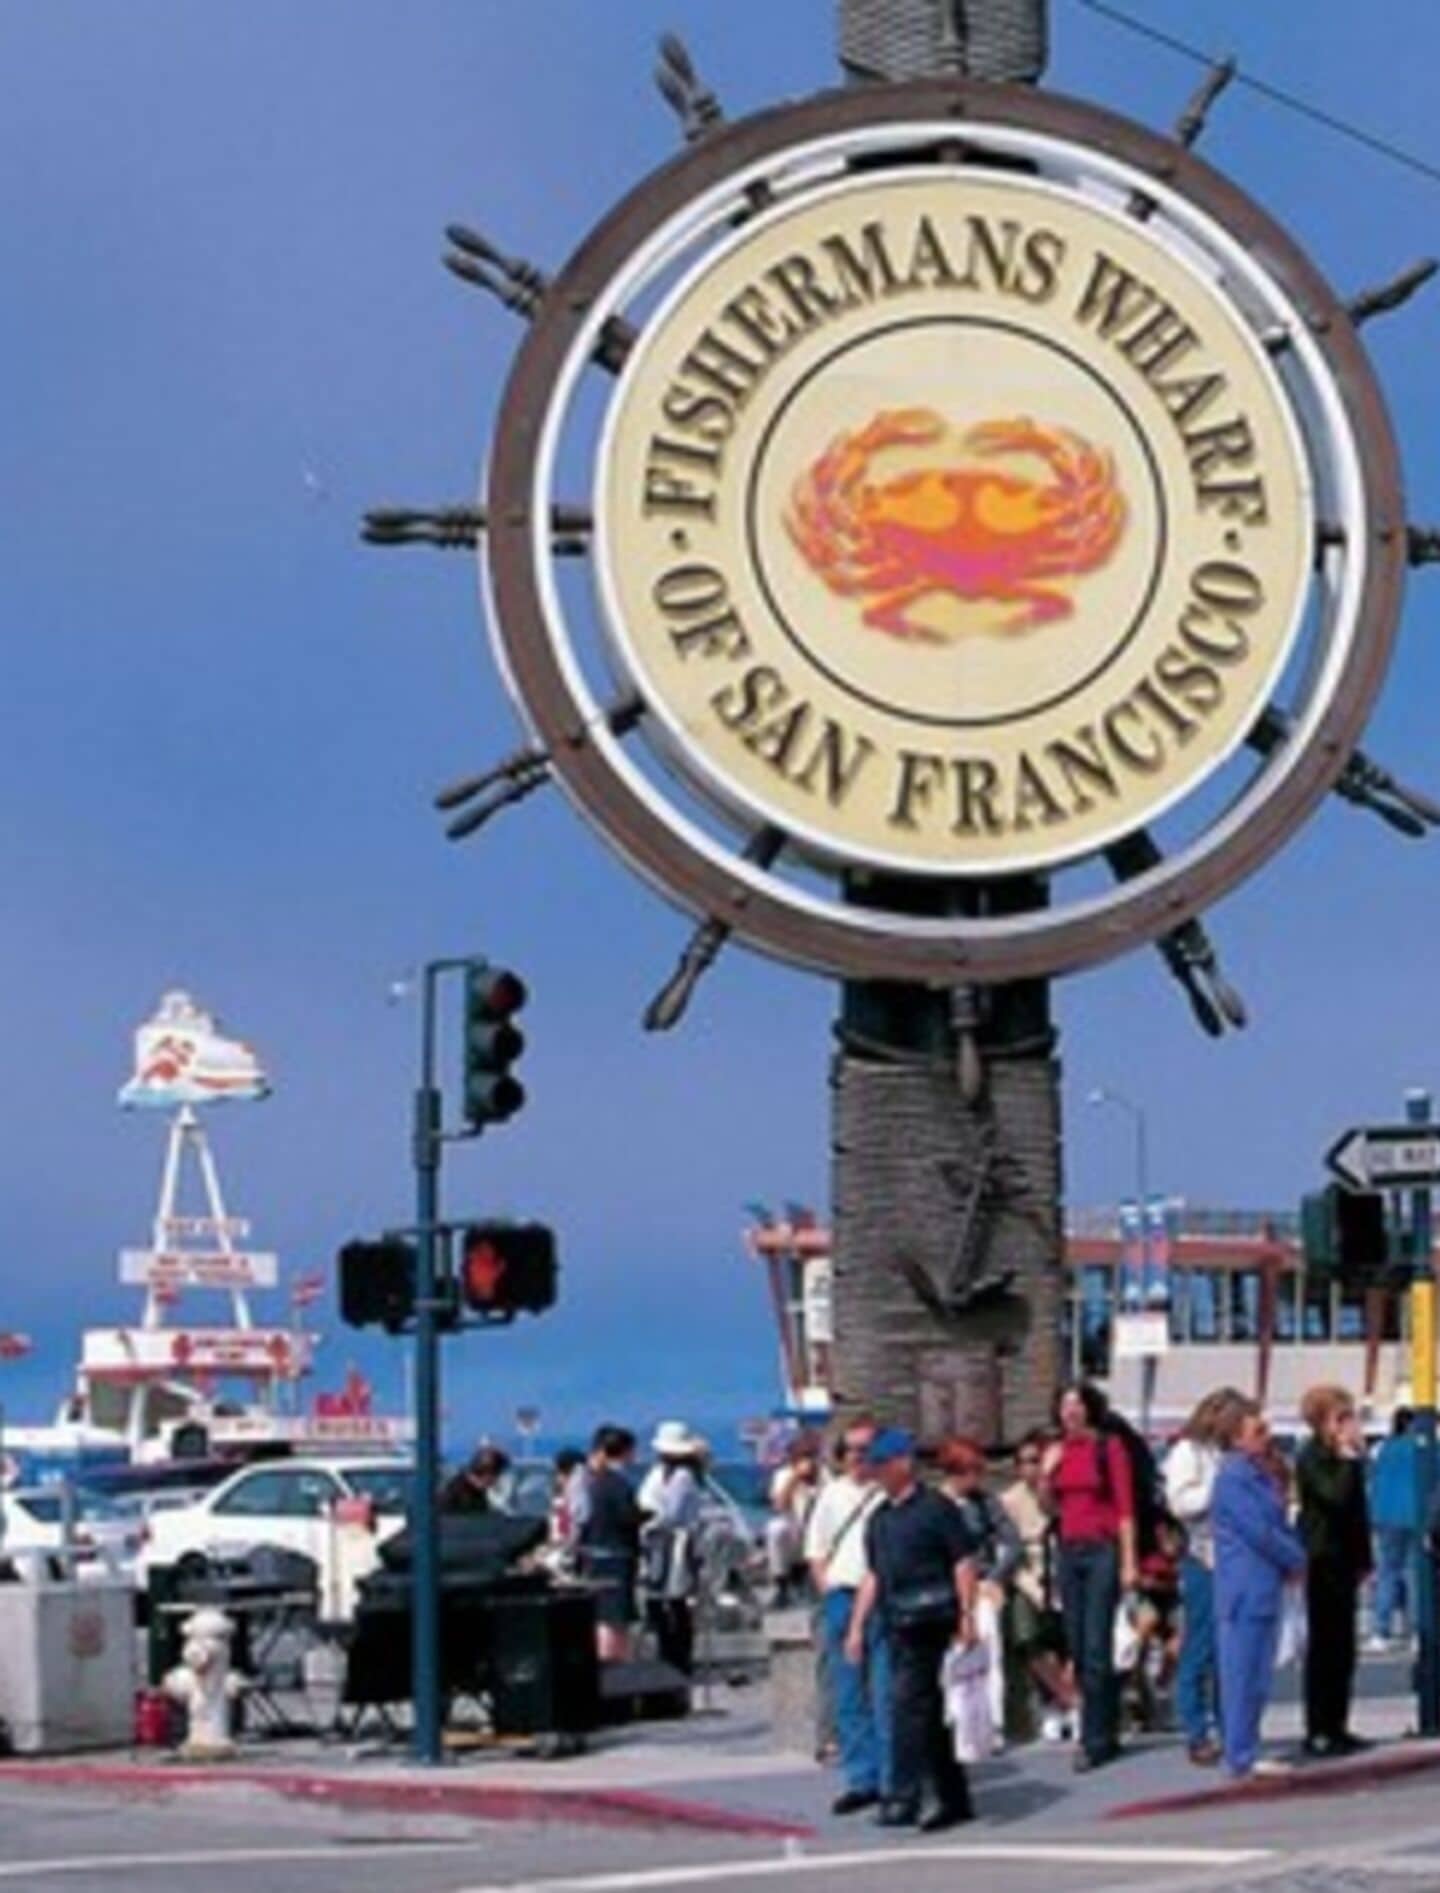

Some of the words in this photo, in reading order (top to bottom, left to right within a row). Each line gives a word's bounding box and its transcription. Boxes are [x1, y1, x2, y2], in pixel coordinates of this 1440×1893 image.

[642, 214, 1066, 523] FISHERMANS
[1072, 250, 1270, 532] WHARF
[652, 562, 752, 663] OF
[709, 663, 875, 802] SAN
[887, 560, 1265, 837] FRANCISCO
